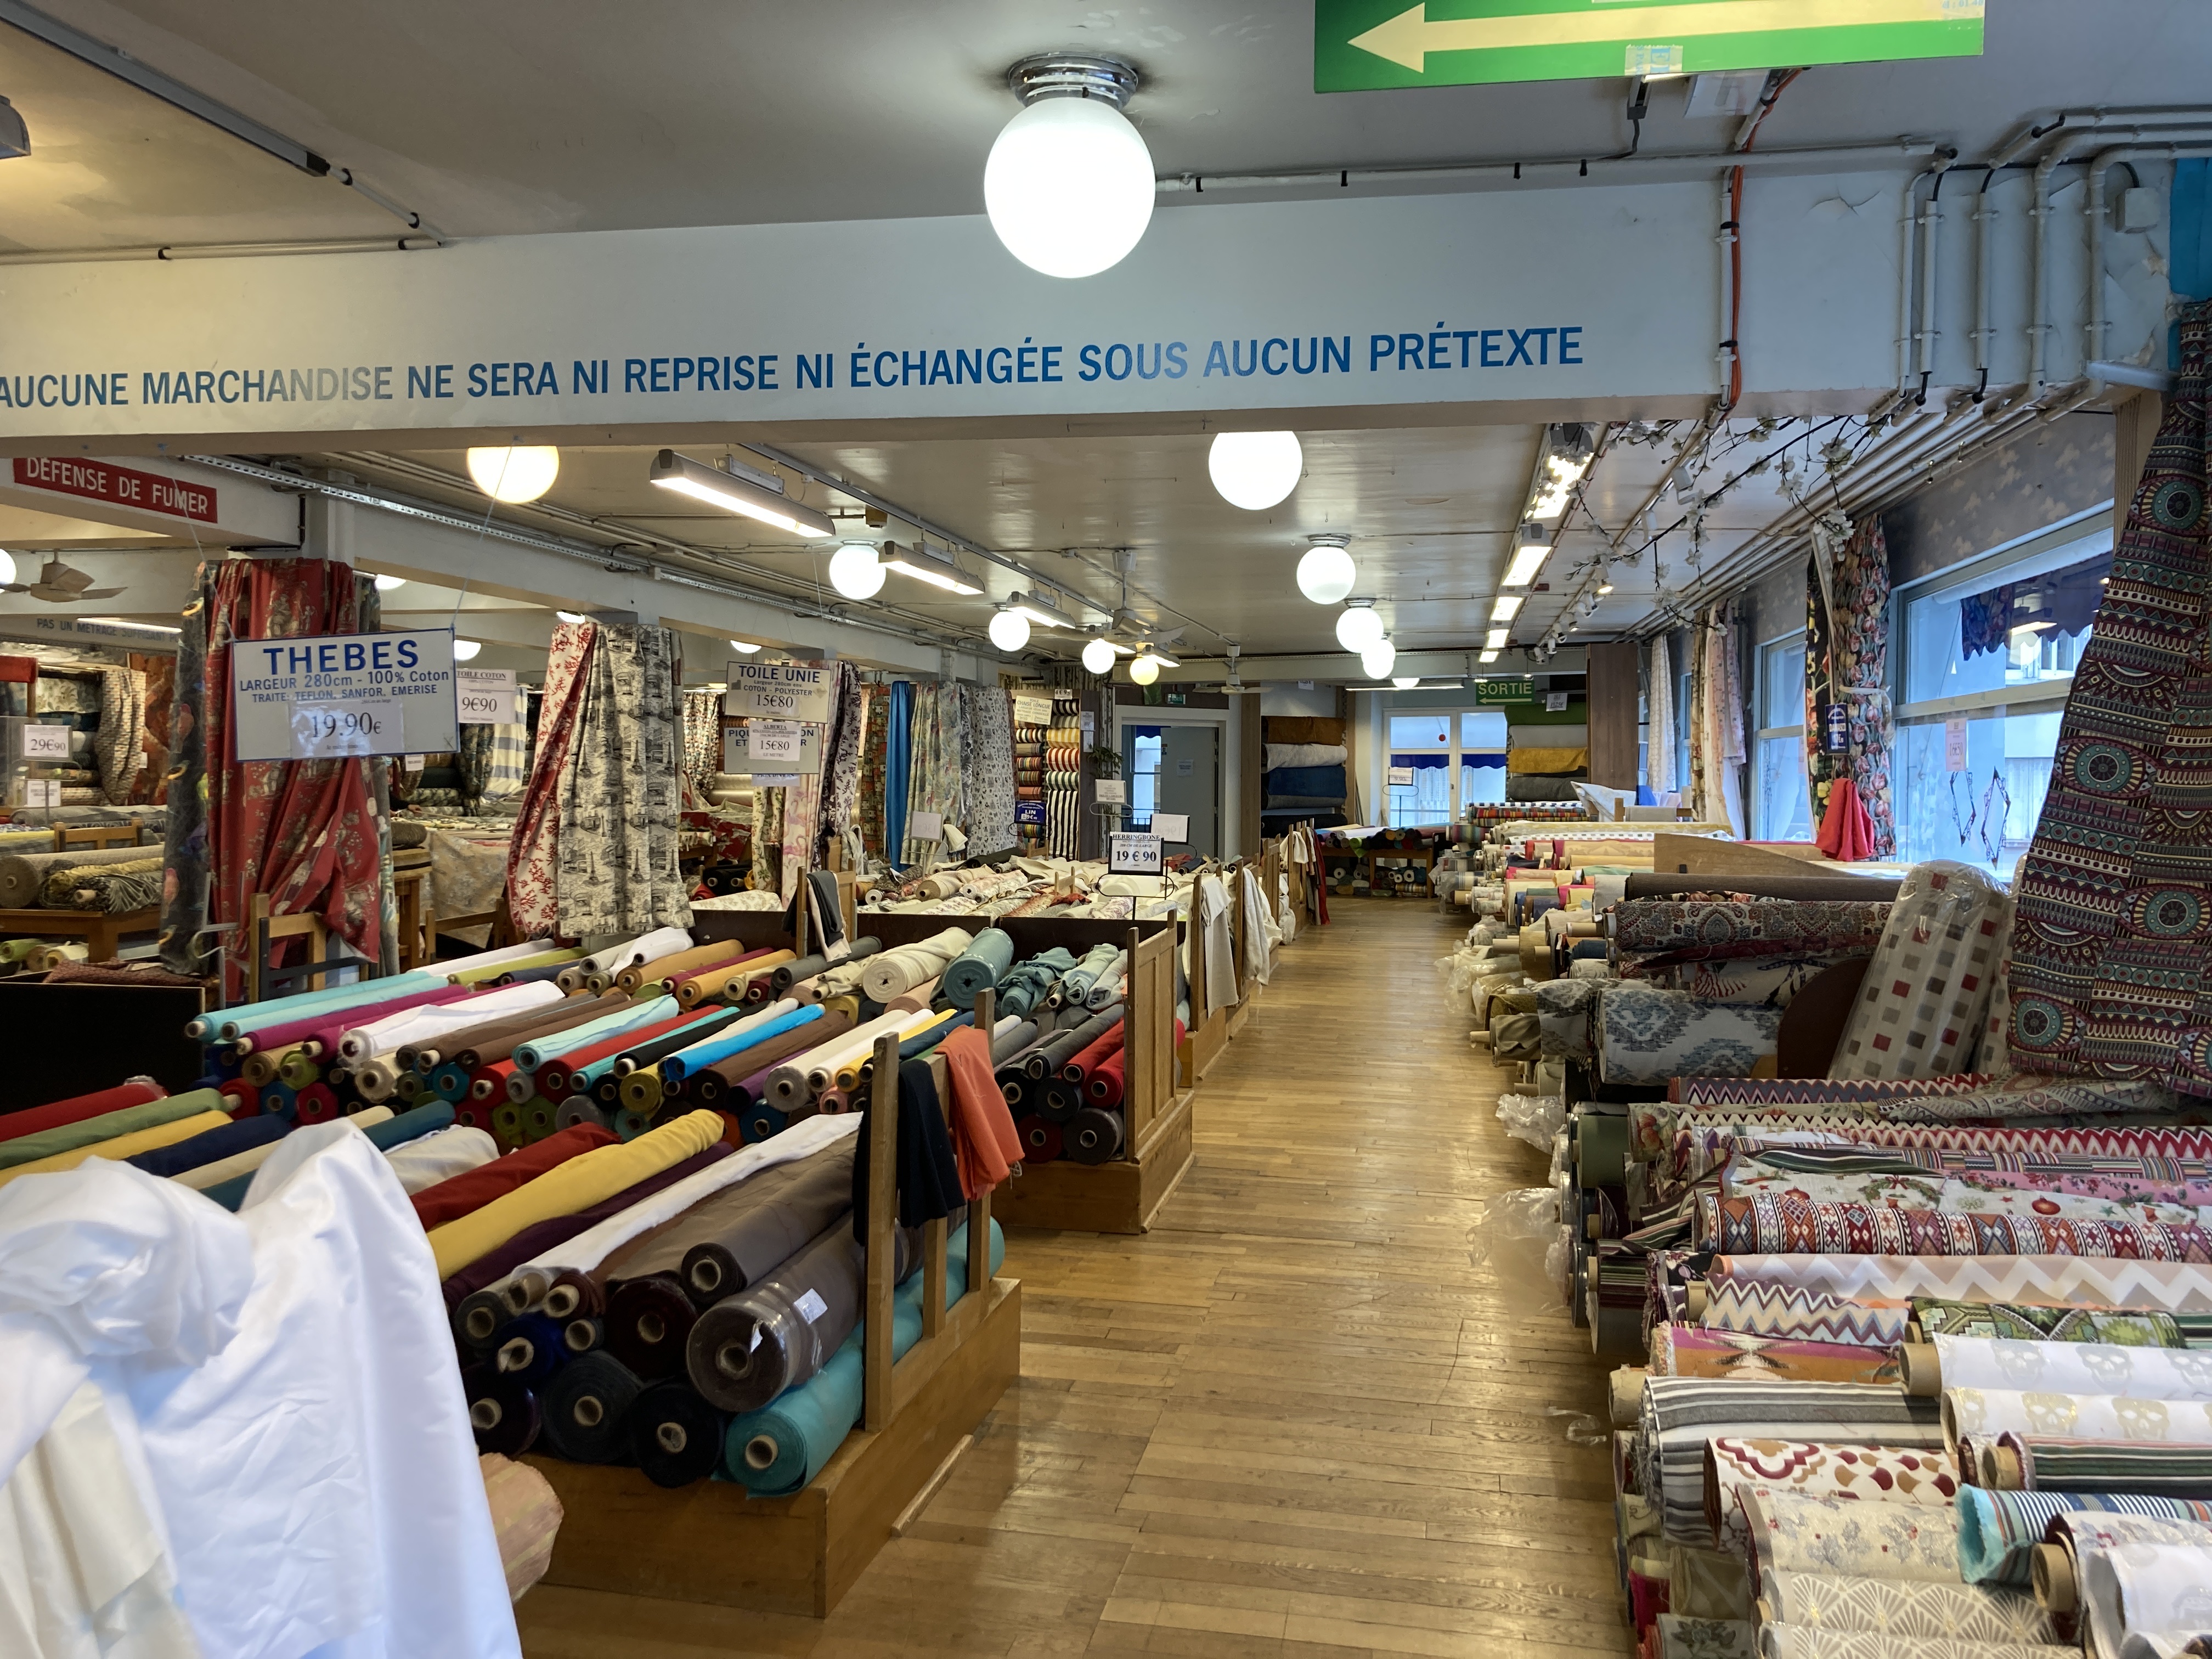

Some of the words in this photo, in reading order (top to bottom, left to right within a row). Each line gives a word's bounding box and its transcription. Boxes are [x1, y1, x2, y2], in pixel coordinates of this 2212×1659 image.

[0, 373, 128, 408] AUCUNE
[143, 366, 393, 405] MARCHANDISE
[408, 364, 454, 399] NE
[467, 362, 559, 397] SERA
[573, 360, 608, 394] NI
[625, 355, 778, 393] REPRISE
[797, 353, 833, 389] NI
[851, 337, 1063, 387] ÉCHANGÉE
[1078, 341, 1188, 381] SOUS
[1203, 336, 1351, 377] AUCUN
[1370, 321, 1583, 371] PRÉTEXTE
[119, 476, 141, 500] DE
[153, 484, 208, 514] FUMER
[37, 618, 54, 629] PAS
[60, 620, 72, 631] UN
[263, 640, 419, 675] THEBES
[240, 677, 297, 691] LARGEUR
[304, 674, 353, 689] 280cm
[368, 671, 404, 684] 100%
[410, 669, 449, 682] Coton
[739, 665, 779, 680] TOILE
[786, 669, 821, 683] UNIE
[392, 685, 437, 696] EMERISE
[775, 687, 812, 696] POLYESTER
[1478, 682, 1532, 695] SORTIE
[461, 697, 497, 712] 9€90
[757, 694, 793, 708] 15€80
[312, 712, 382, 738] 19.90€
[31, 738, 66, 751] 29€90
[760, 740, 789, 751] 15€80
[1116, 851, 1129, 861] 19
[1132, 851, 1139, 861] €
[1143, 851, 1156, 862] 90
